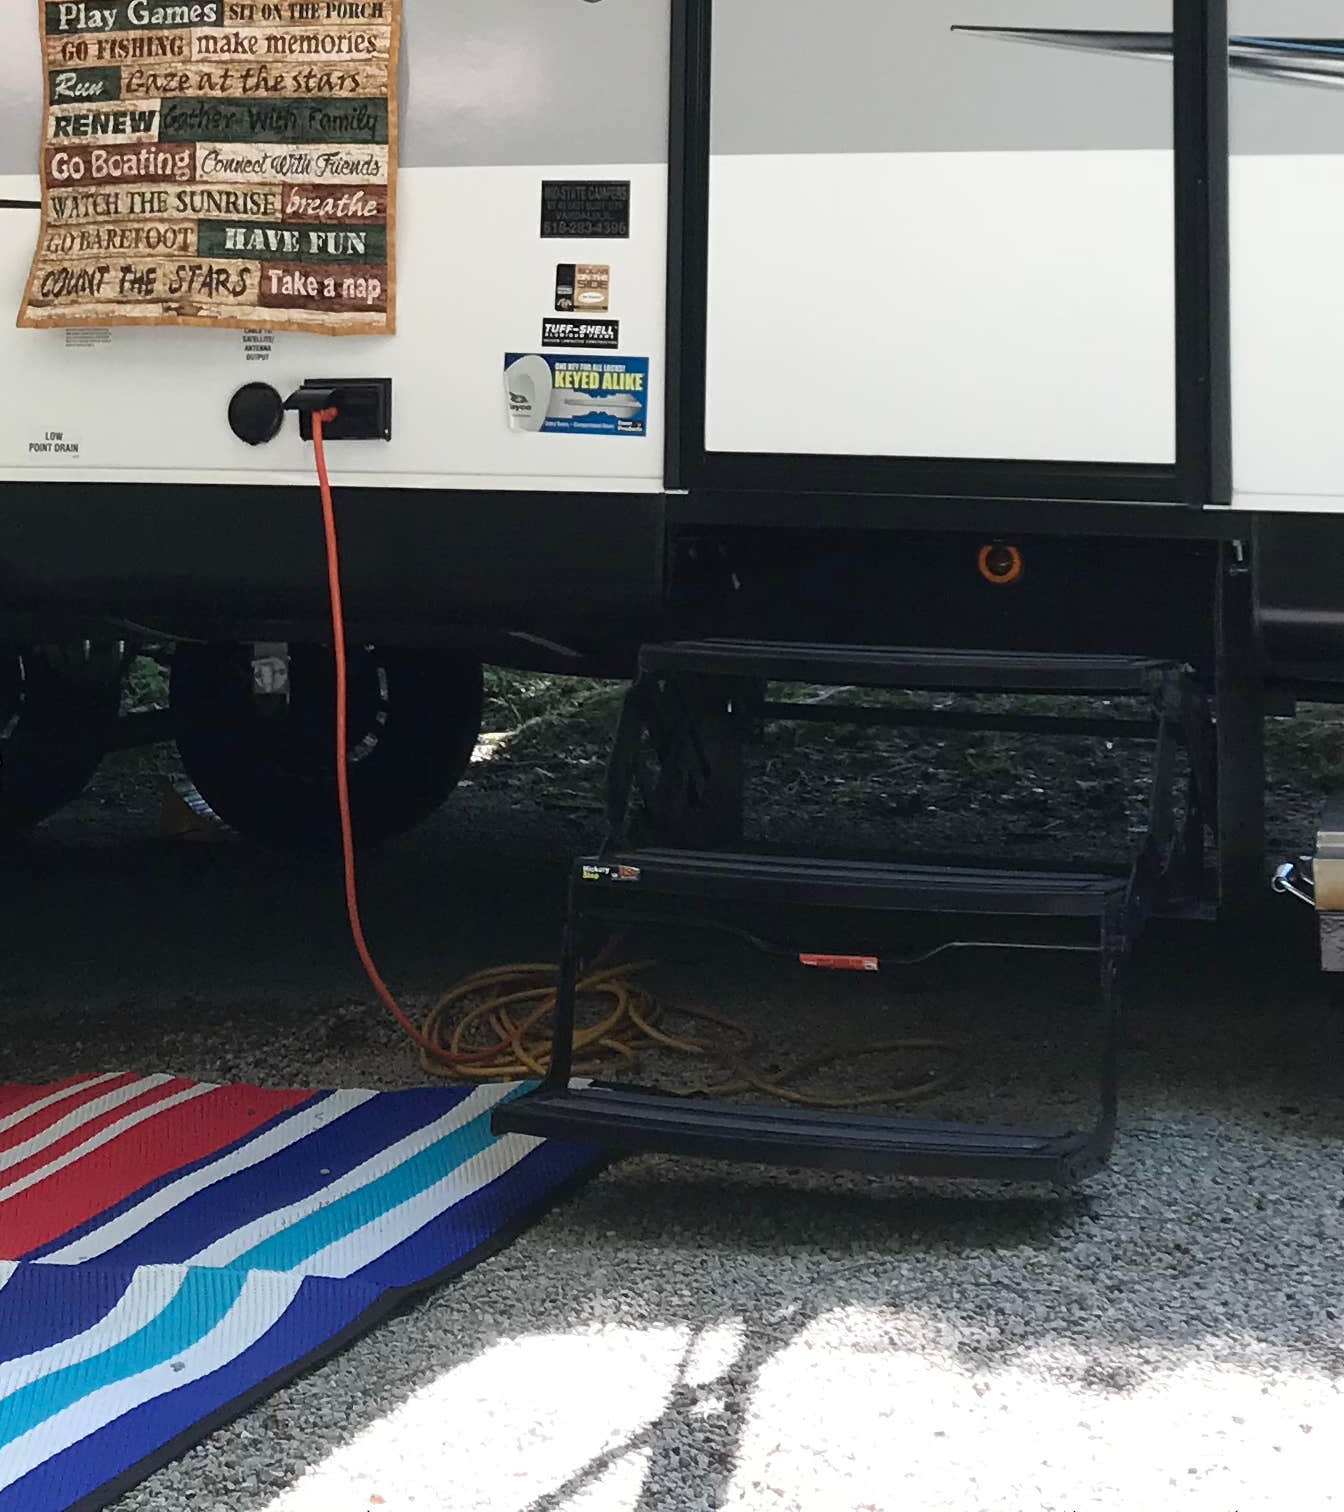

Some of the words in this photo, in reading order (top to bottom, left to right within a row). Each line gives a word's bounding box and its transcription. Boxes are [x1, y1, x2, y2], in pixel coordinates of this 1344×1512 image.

[58, 3, 117, 29] Play
[228, 3, 257, 21] SIT
[261, 3, 283, 21] ON
[288, 3, 320, 20] THE
[325, 3, 384, 19] PORCH
[61, 39, 90, 62] GO
[96, 35, 184, 60] FISHING
[196, 32, 259, 54] make
[265, 29, 378, 54] memories
[54, 73, 104, 100] Run
[125, 69, 191, 93] Gaze
[197, 67, 230, 92] at
[236, 66, 290, 93] the
[293, 68, 360, 93] stars
[53, 109, 157, 138] RENEW
[163, 102, 238, 132] Gather
[247, 104, 298, 134] With
[306, 103, 379, 139] Family
[51, 156, 85, 180] Go
[91, 148, 191, 180] Boating
[201, 150, 266, 176] Connect
[270, 155, 313, 175] With
[315, 152, 380, 177] Friends
[50, 194, 119, 219] WATCH
[126, 192, 169, 217] THE
[176, 190, 277, 216] SUNRISE
[287, 189, 378, 217] breathe
[47, 231, 76, 255] GO
[78, 225, 194, 252] BAREFOOT
[224, 229, 300, 252] HAVE
[308, 230, 367, 255] FUN
[41, 265, 109, 299] COUNT
[118, 265, 158, 298] THE
[168, 264, 251, 298] STARS
[269, 270, 321, 297] Take
[323, 276, 336, 296] a
[342, 276, 381, 303] nap
[577, 280, 608, 288] SIDE
[544, 323, 614, 335] TUFF-SHELL
[246, 353, 270, 361] OUTPUT
[555, 371, 600, 389] KEYED
[602, 372, 644, 391] ALIKE
[29, 442, 52, 453] POINT
[54, 443, 79, 453] DRAIN
[45, 431, 64, 441] LOW
